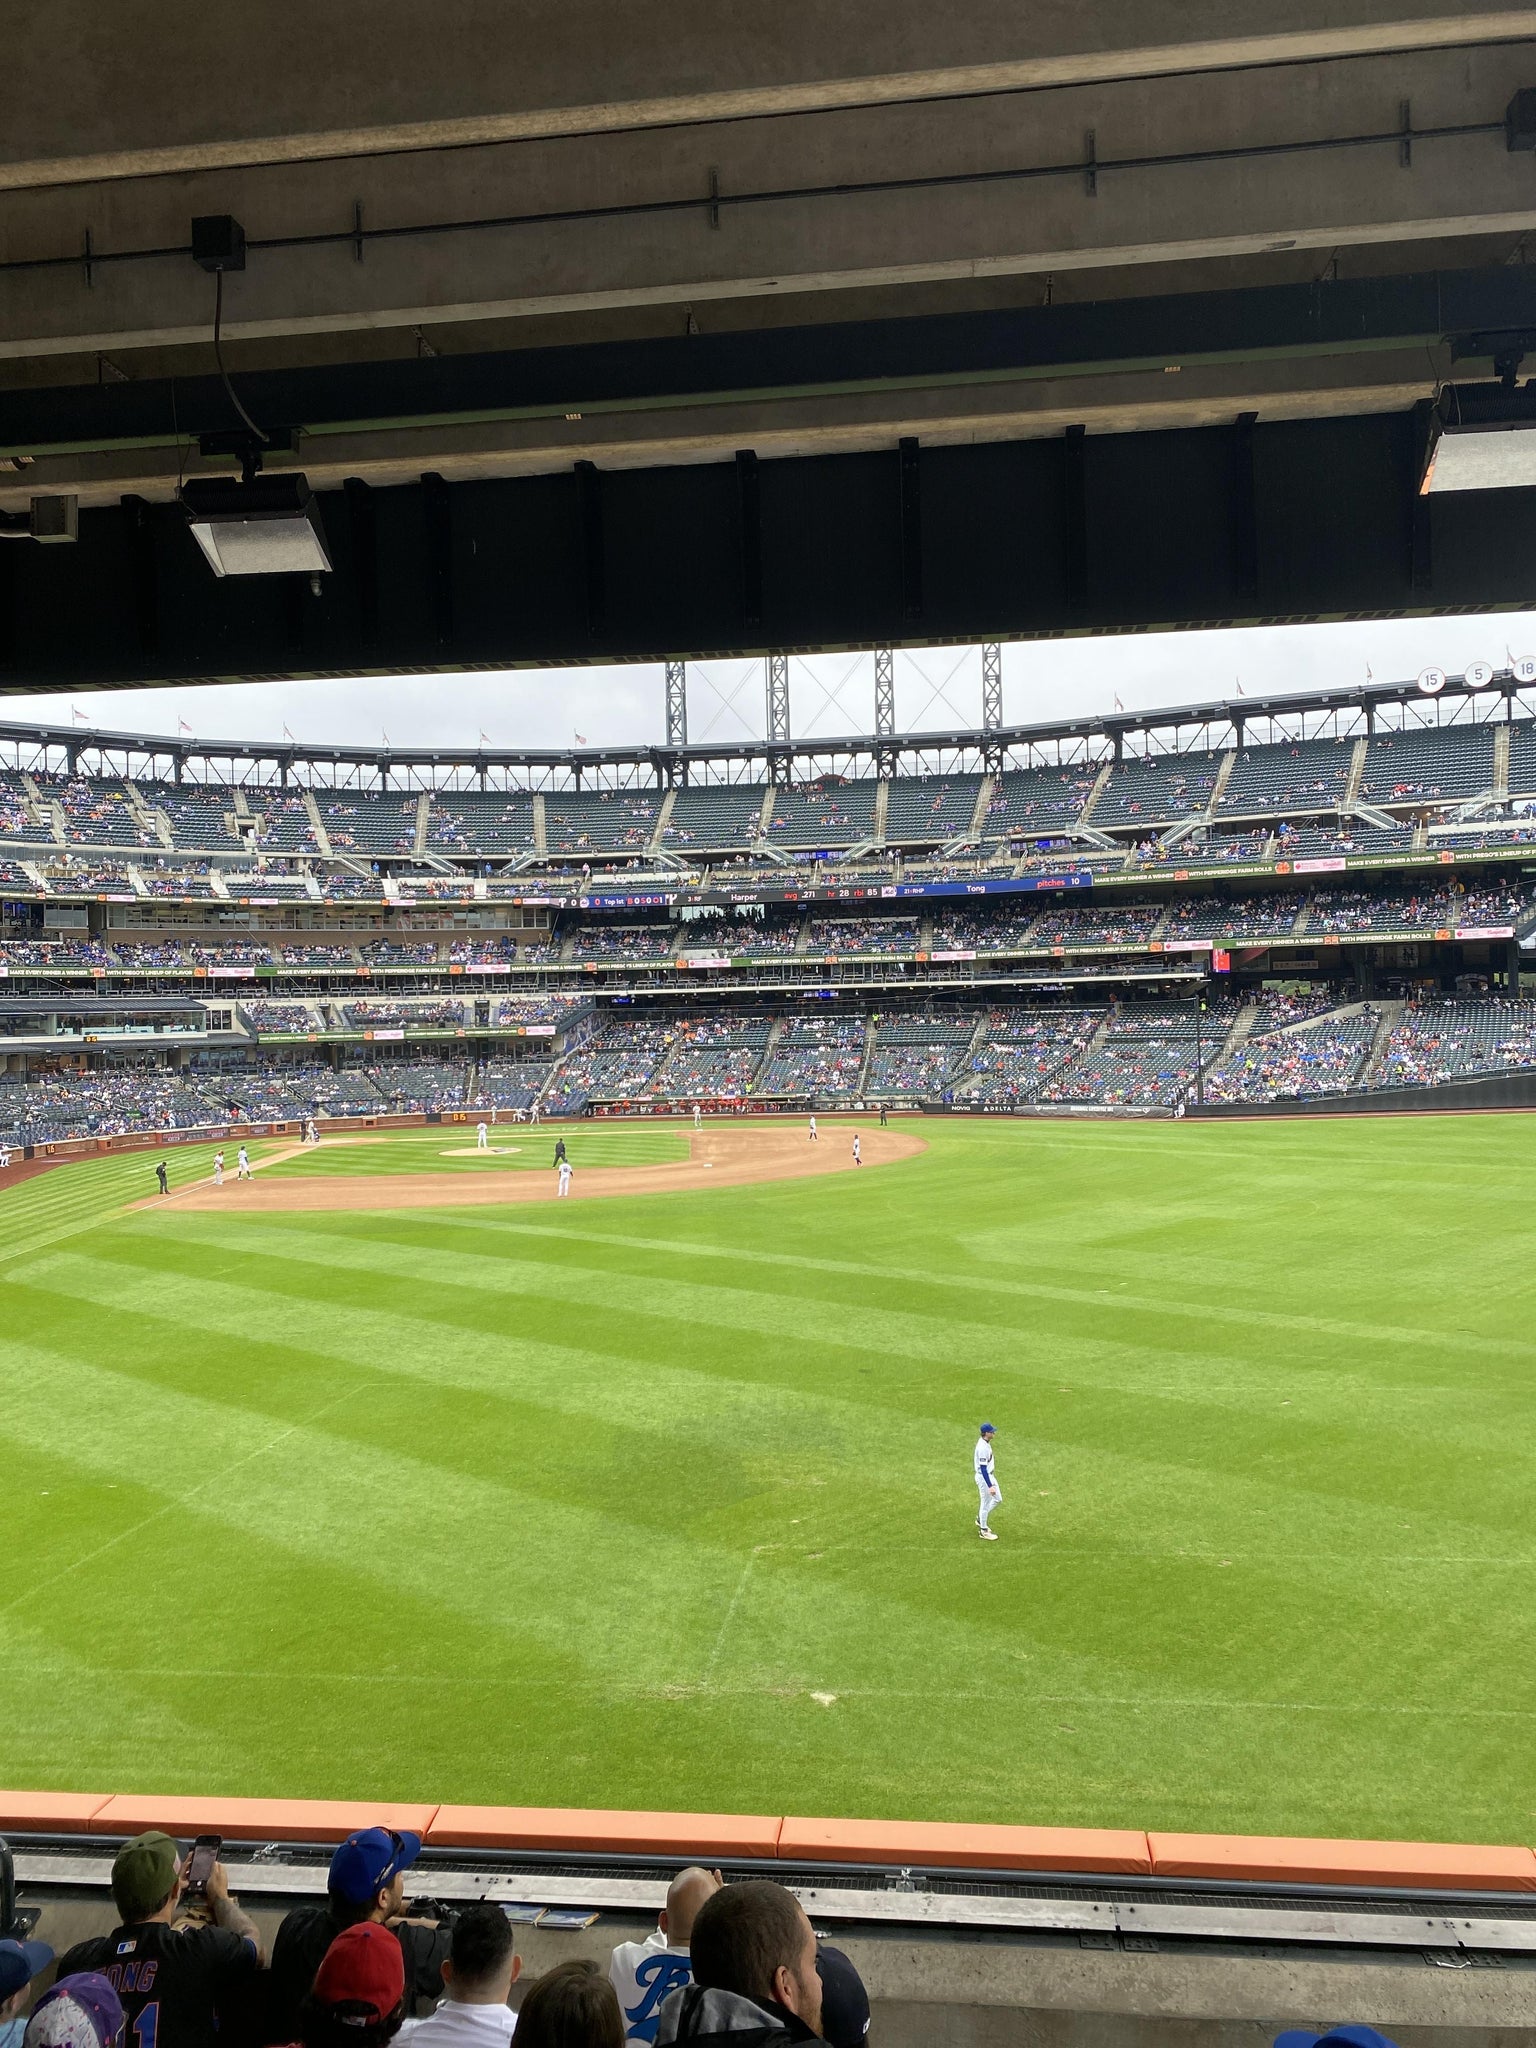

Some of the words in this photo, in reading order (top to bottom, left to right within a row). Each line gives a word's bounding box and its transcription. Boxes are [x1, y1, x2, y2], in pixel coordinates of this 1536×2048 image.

[1521, 662, 1534, 674] 18
[1426, 674, 1437, 686] 15
[1475, 669, 1483, 680] 5
[966, 885, 985, 893] Tong
[1037, 879, 1065, 889] pitches
